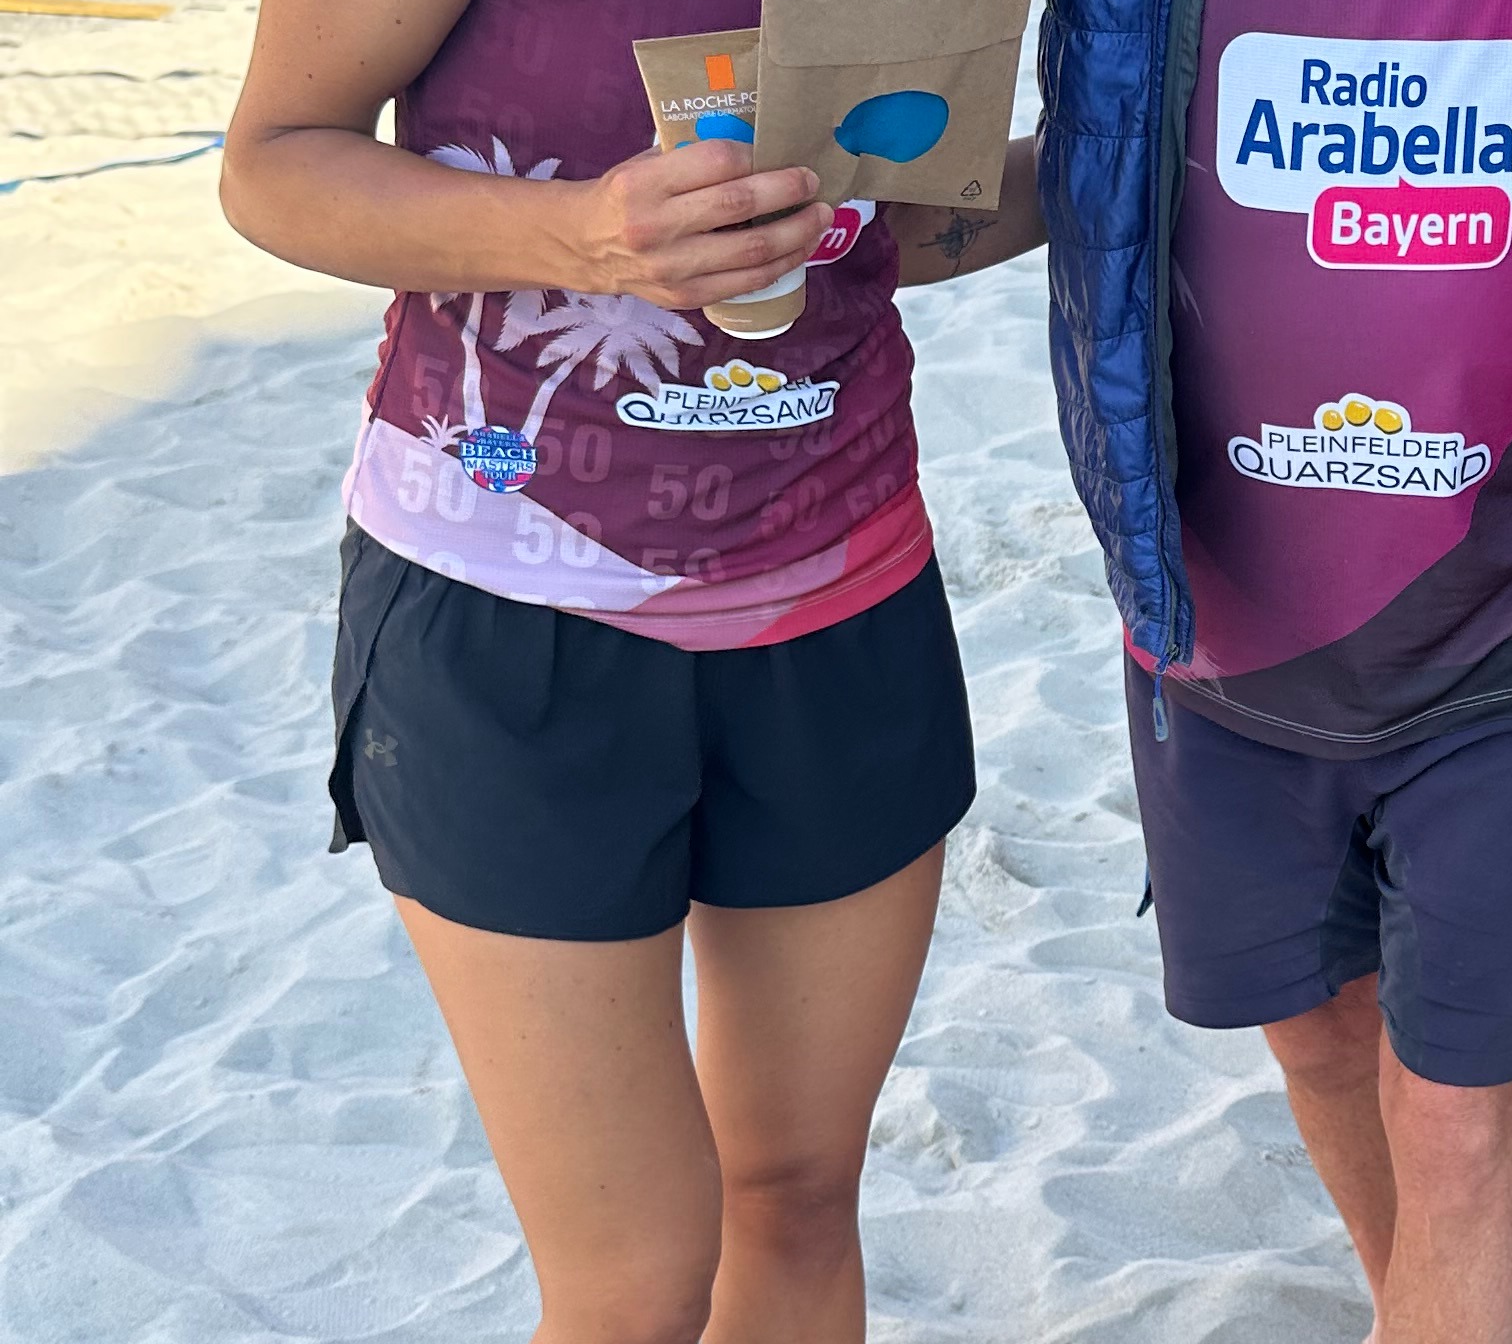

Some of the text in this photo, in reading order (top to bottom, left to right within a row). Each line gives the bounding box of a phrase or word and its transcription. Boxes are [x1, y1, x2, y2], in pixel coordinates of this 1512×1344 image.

[1300, 58, 1428, 108] Radio
[661, 90, 759, 113] LA ROCHE-PO
[1331, 200, 1494, 257] Bayern
[461, 441, 537, 461] BEACH
[1268, 431, 1459, 459] PLEINFELDER
[466, 459, 534, 472] MASTERS
[483, 469, 517, 481] TOUR
[1233, 442, 1487, 492] QUARZSAND
